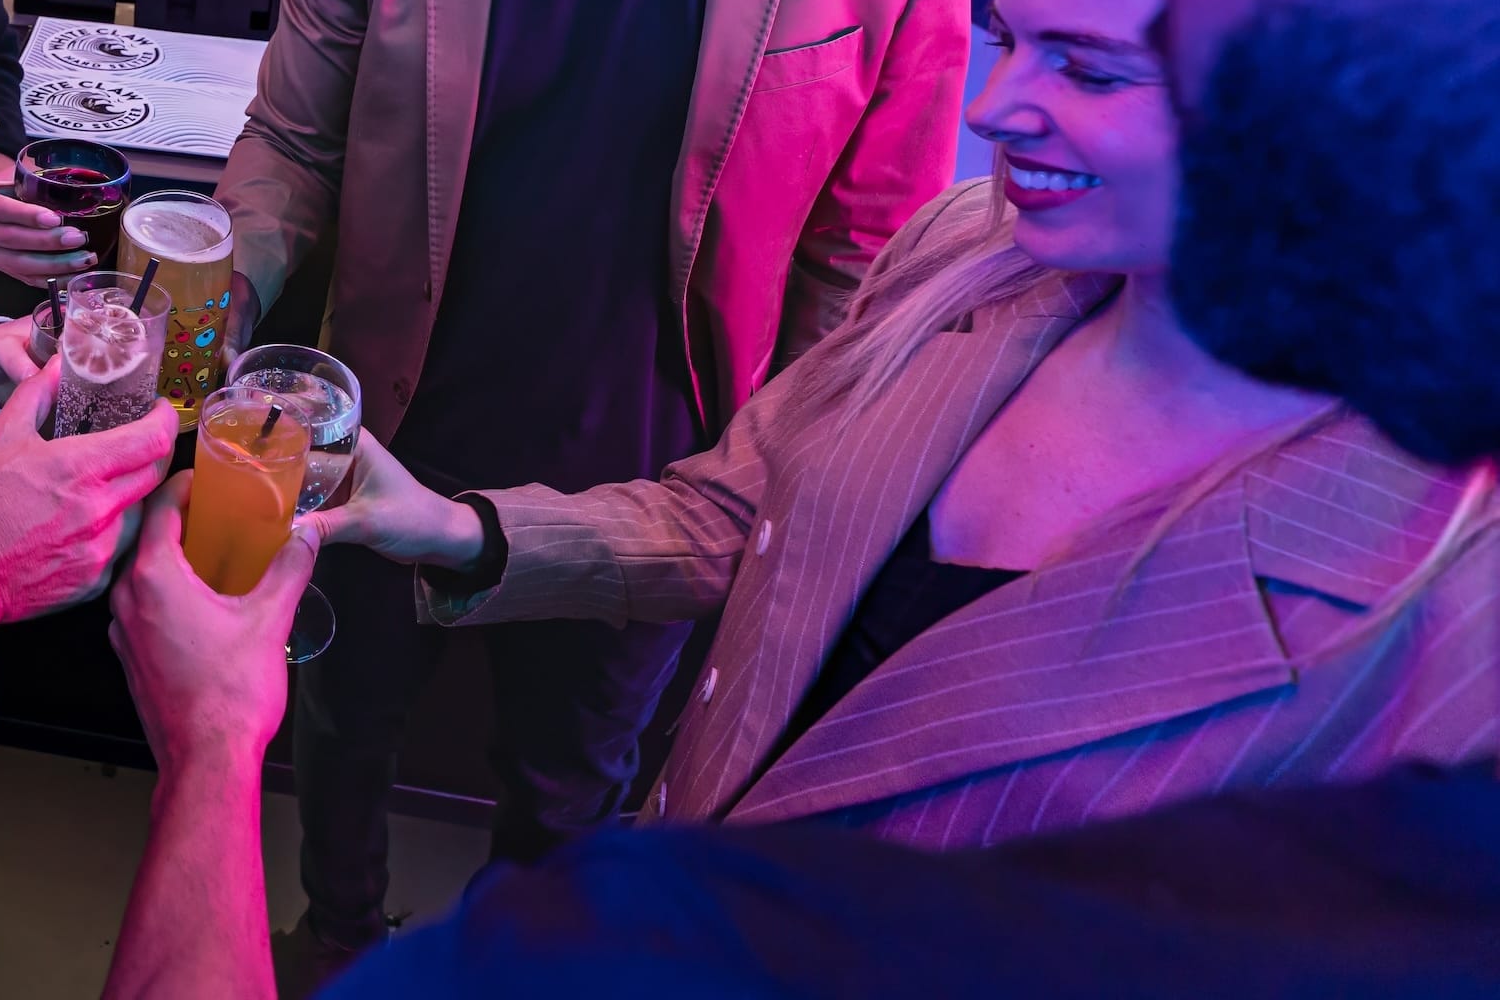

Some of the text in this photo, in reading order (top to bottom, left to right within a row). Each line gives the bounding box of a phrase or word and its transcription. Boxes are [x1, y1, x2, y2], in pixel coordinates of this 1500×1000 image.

[48, 28, 154, 51] WHITE CLAW
[63, 55, 101, 68] HARD
[25, 80, 144, 107] WHITE CLAW
[41, 108, 143, 129] HARD SELTZER
